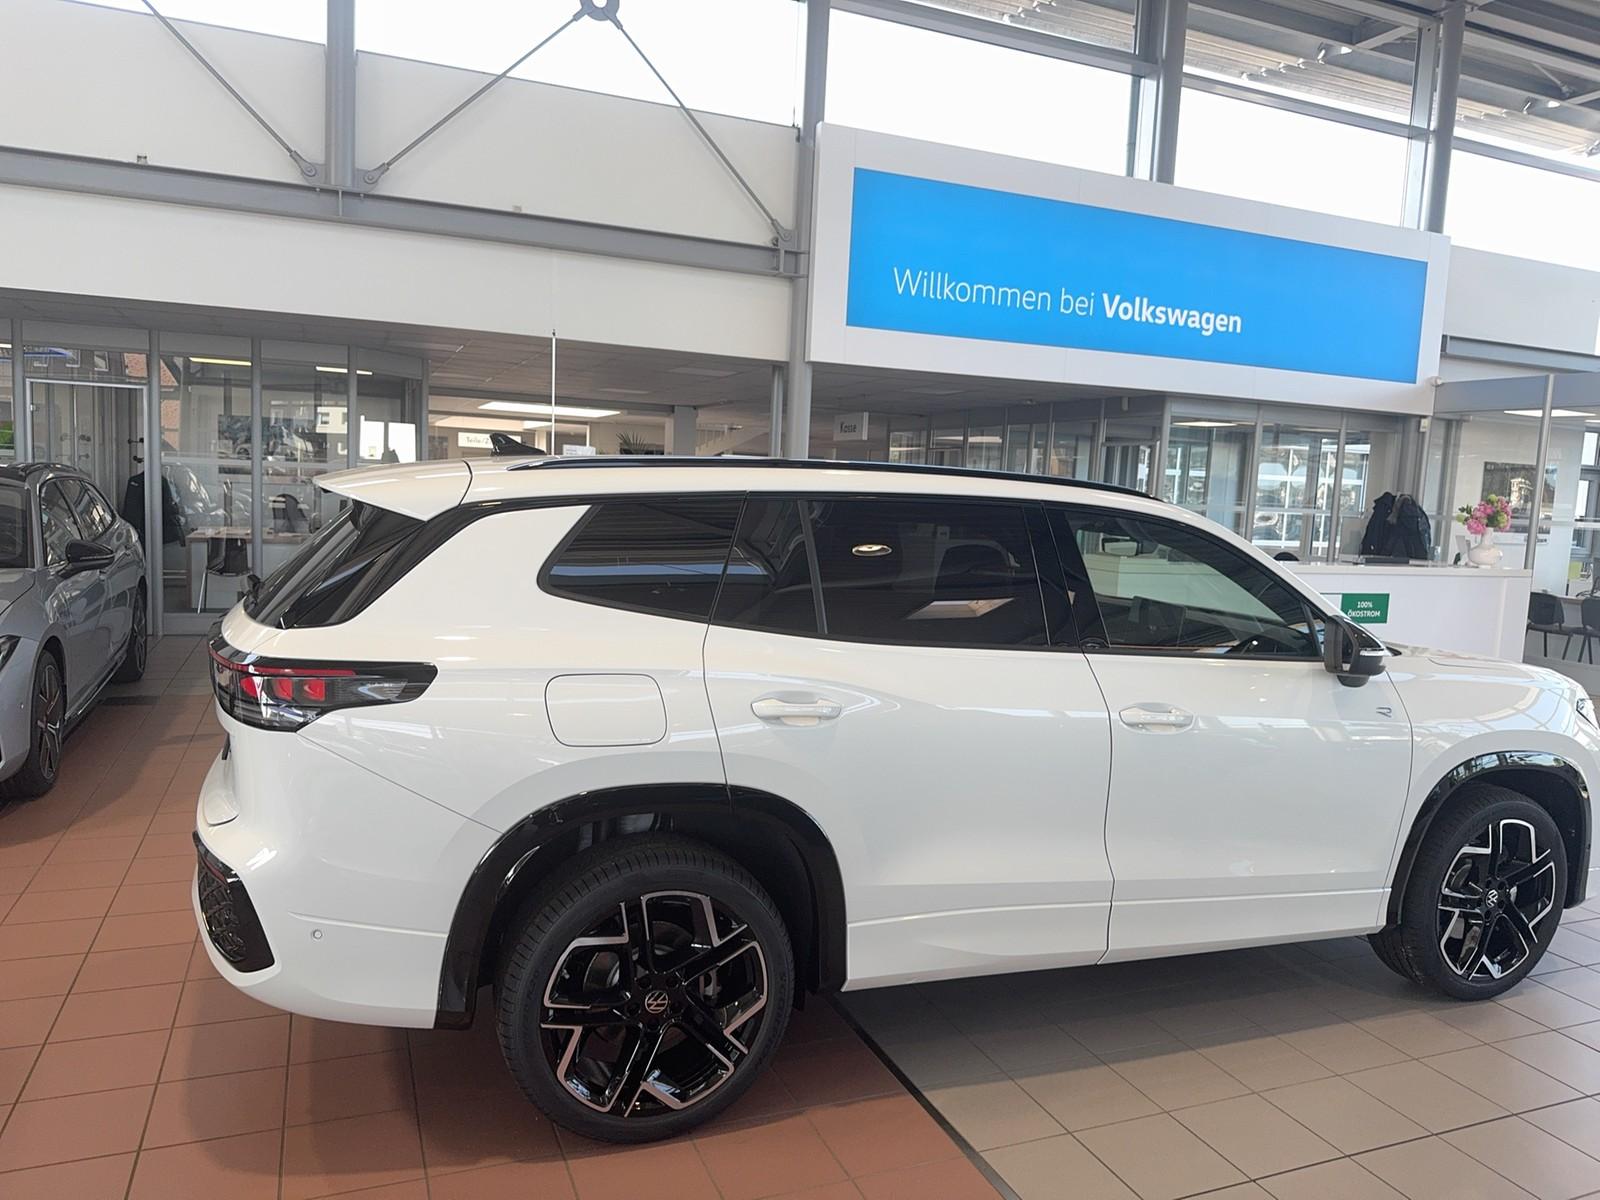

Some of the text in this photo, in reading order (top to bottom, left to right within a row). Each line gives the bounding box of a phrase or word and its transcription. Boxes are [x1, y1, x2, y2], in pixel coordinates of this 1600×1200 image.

[893, 266, 1242, 336] Willkommen bei Volkswagen
[1357, 601, 1373, 609] 100%
[1347, 609, 1381, 618] ÖKOSTROM
